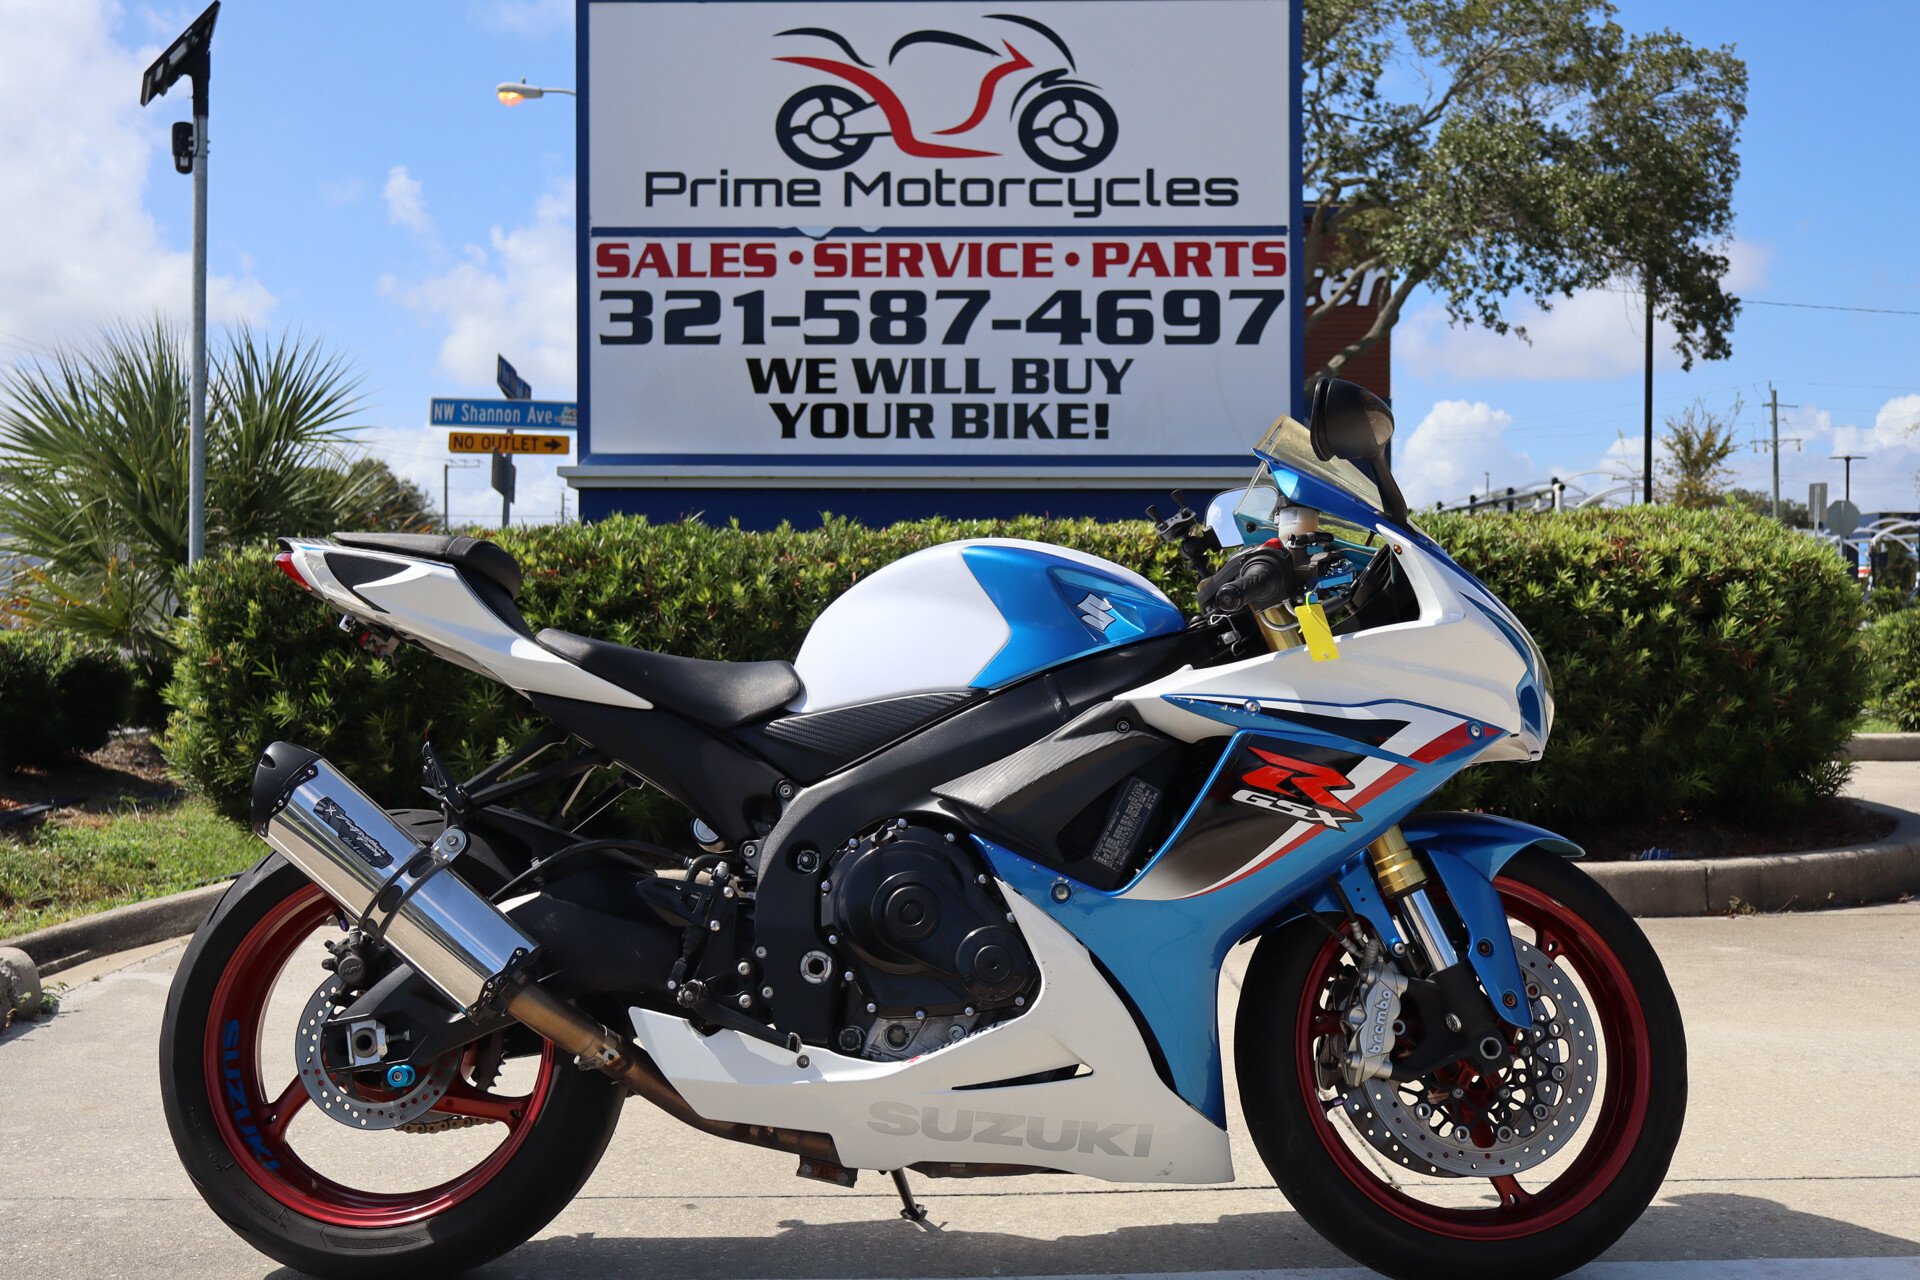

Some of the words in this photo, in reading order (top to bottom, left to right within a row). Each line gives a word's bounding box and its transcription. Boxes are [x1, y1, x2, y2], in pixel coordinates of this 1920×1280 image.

[646, 169, 821, 207] Prime
[844, 169, 1239, 219] Motorcycles
[596, 243, 777, 278] SALES
[814, 242, 1054, 278] SERVICE
[1092, 241, 1287, 278] PARTS
[599, 289, 1285, 346] 321-587-4697
[746, 358, 837, 395] WE
[852, 358, 995, 395] WILL
[1012, 358, 1134, 395] BUY
[433, 403, 455, 420] NW
[461, 403, 520, 423] Shannon
[527, 406, 553, 424] Ave
[769, 403, 936, 439] YOUR
[951, 403, 1110, 439] BIKE!
[453, 435, 474, 449] NO
[481, 436, 540, 451] OUTLET
[1368, 990, 1392, 1054] brembo
[223, 1019, 281, 1170] SUZUKI
[866, 1101, 1154, 1157] SUZUKI
